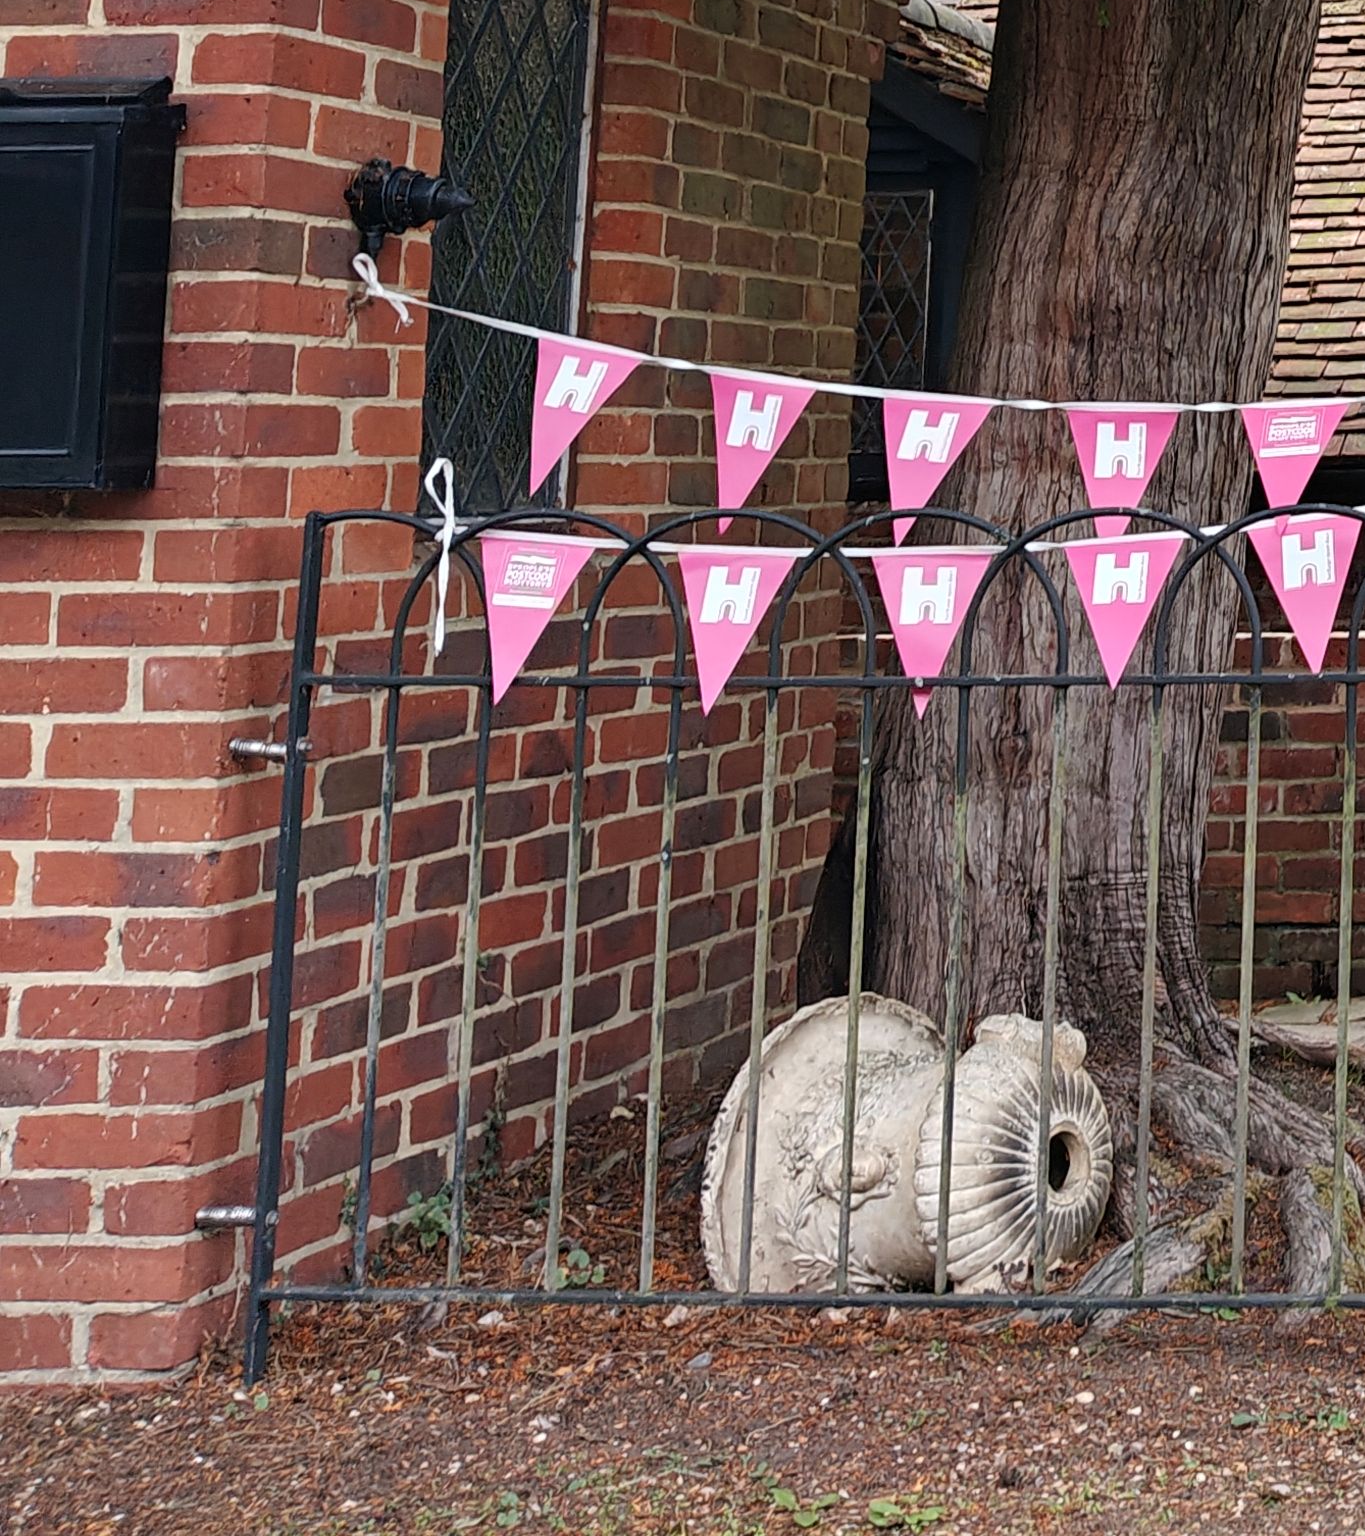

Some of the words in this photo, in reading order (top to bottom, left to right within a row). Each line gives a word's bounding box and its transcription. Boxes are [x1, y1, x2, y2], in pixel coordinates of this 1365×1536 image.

[543, 355, 609, 413] H
[726, 390, 784, 452] H
[896, 409, 960, 463] H
[1094, 422, 1146, 479] H
[506, 569, 555, 583] POSTCODE
[1092, 552, 1149, 604] H
[1281, 529, 1336, 592] H
[699, 566, 762, 624] H
[899, 566, 957, 625] H
